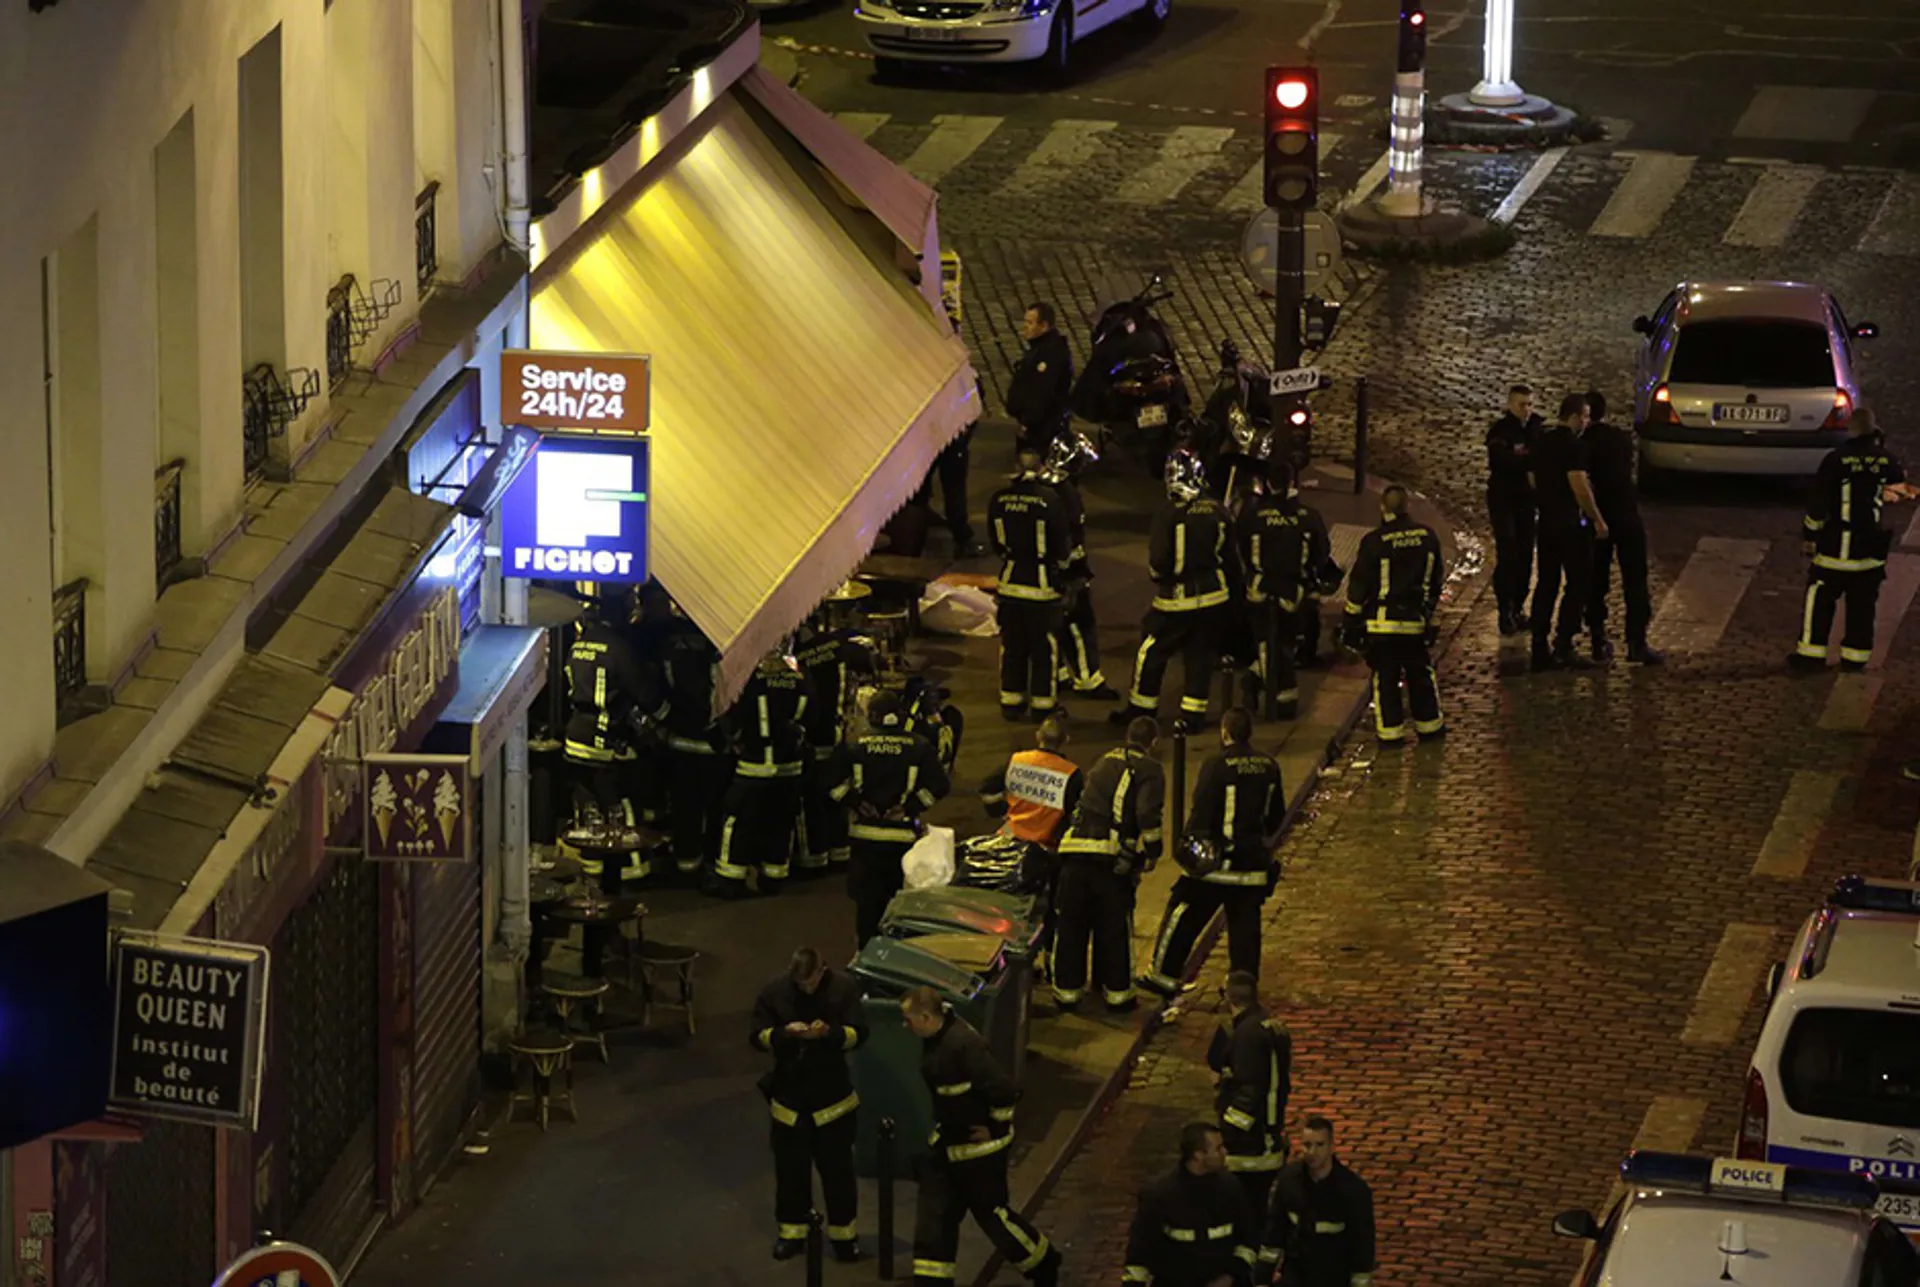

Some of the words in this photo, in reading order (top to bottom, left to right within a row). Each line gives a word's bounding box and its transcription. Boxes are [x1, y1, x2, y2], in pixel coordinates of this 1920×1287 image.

[521, 363, 627, 392] Service
[520, 390, 625, 420] 24h/24
[866, 743, 903, 756] PARIS
[1009, 766, 1065, 789] POMPIERS
[132, 957, 243, 999] BEAUTY
[136, 991, 227, 1031] QUEEN
[132, 1033, 229, 1065] institut
[162, 1061, 192, 1081] de
[134, 1076, 221, 1106] beauté
[1721, 1168, 1774, 1184] POLICE
[1849, 1157, 1920, 1180] POLI
